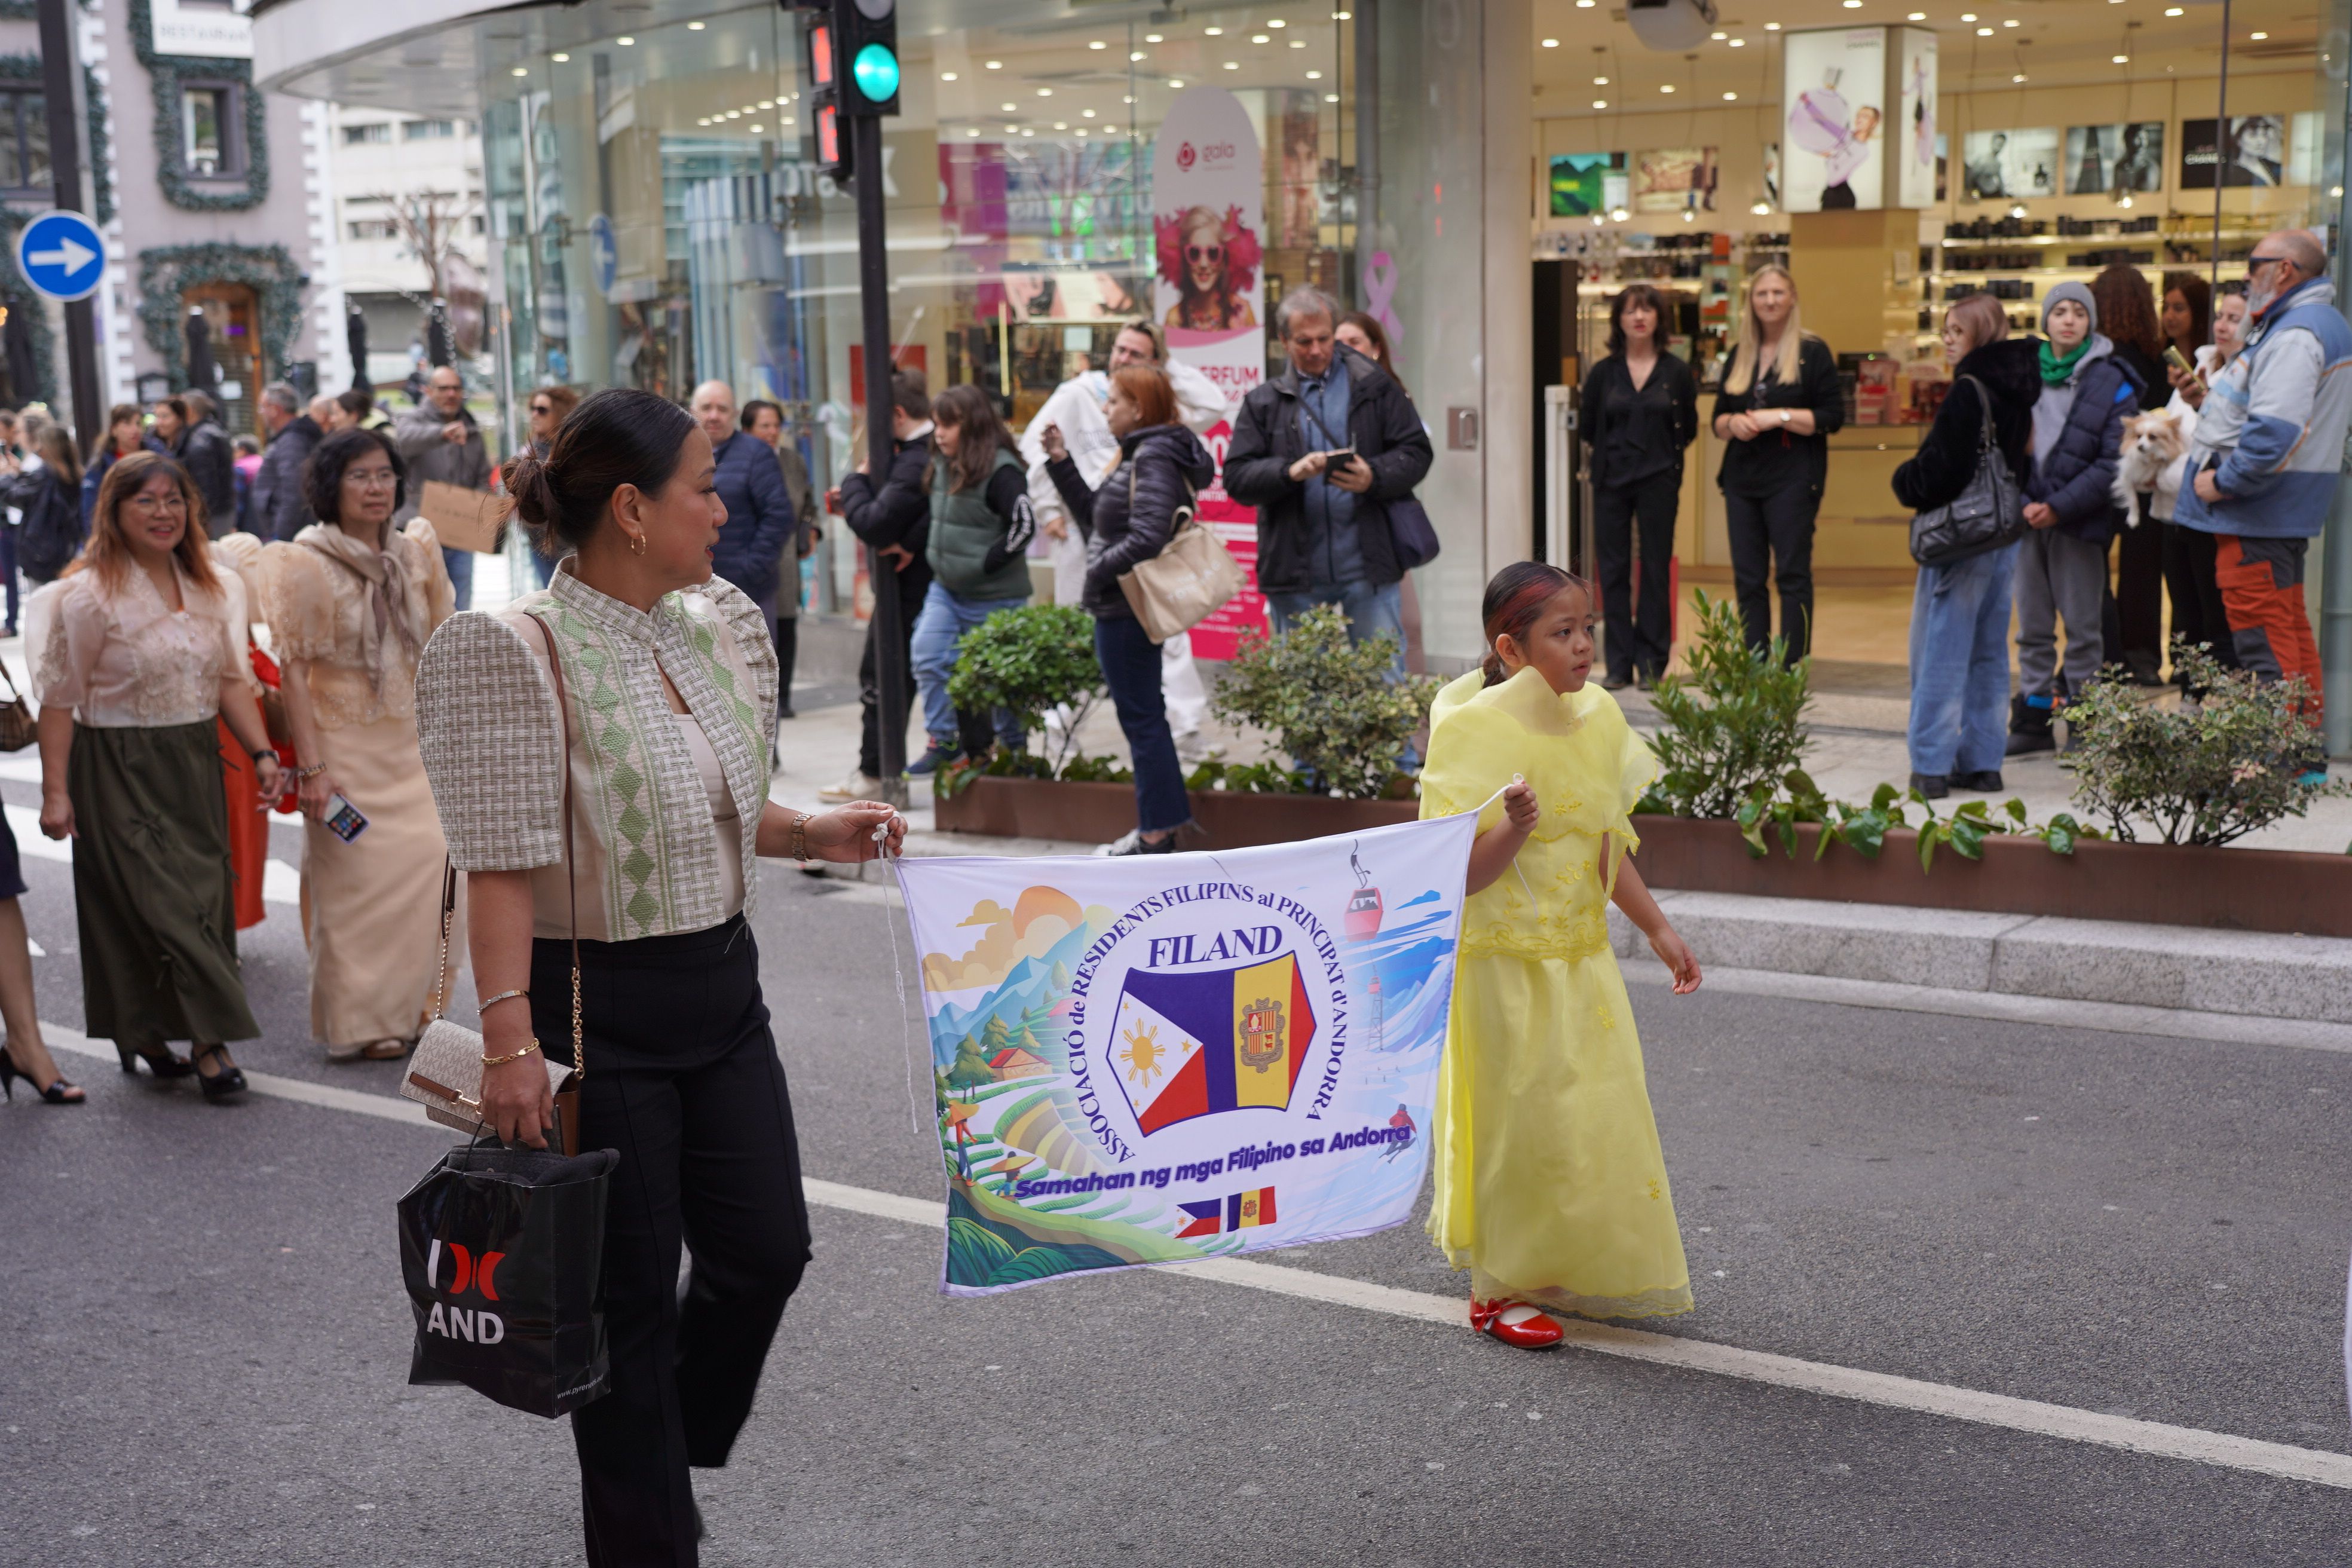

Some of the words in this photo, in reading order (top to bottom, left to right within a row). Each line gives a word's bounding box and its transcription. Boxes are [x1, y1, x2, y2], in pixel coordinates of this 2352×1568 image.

[1160, 883, 1254, 908] FILIPINS
[1257, 892, 1275, 908] al
[1071, 897, 1163, 999] RESIDENTS
[1146, 925, 1283, 968] FILAND
[1276, 896, 1345, 986] PRINCIPAT
[1069, 1002, 1085, 1025] de
[1063, 1030, 1136, 1163] ASSOCIACIÓ
[1015, 1171, 1135, 1198] Samahan
[1140, 1166, 1171, 1189] ng
[1175, 1157, 1223, 1183] mga
[1227, 1140, 1296, 1171] Filipino
[1299, 1138, 1325, 1156] sa
[1329, 1125, 1411, 1153] Andorra
[427, 1302, 505, 1345] AND
